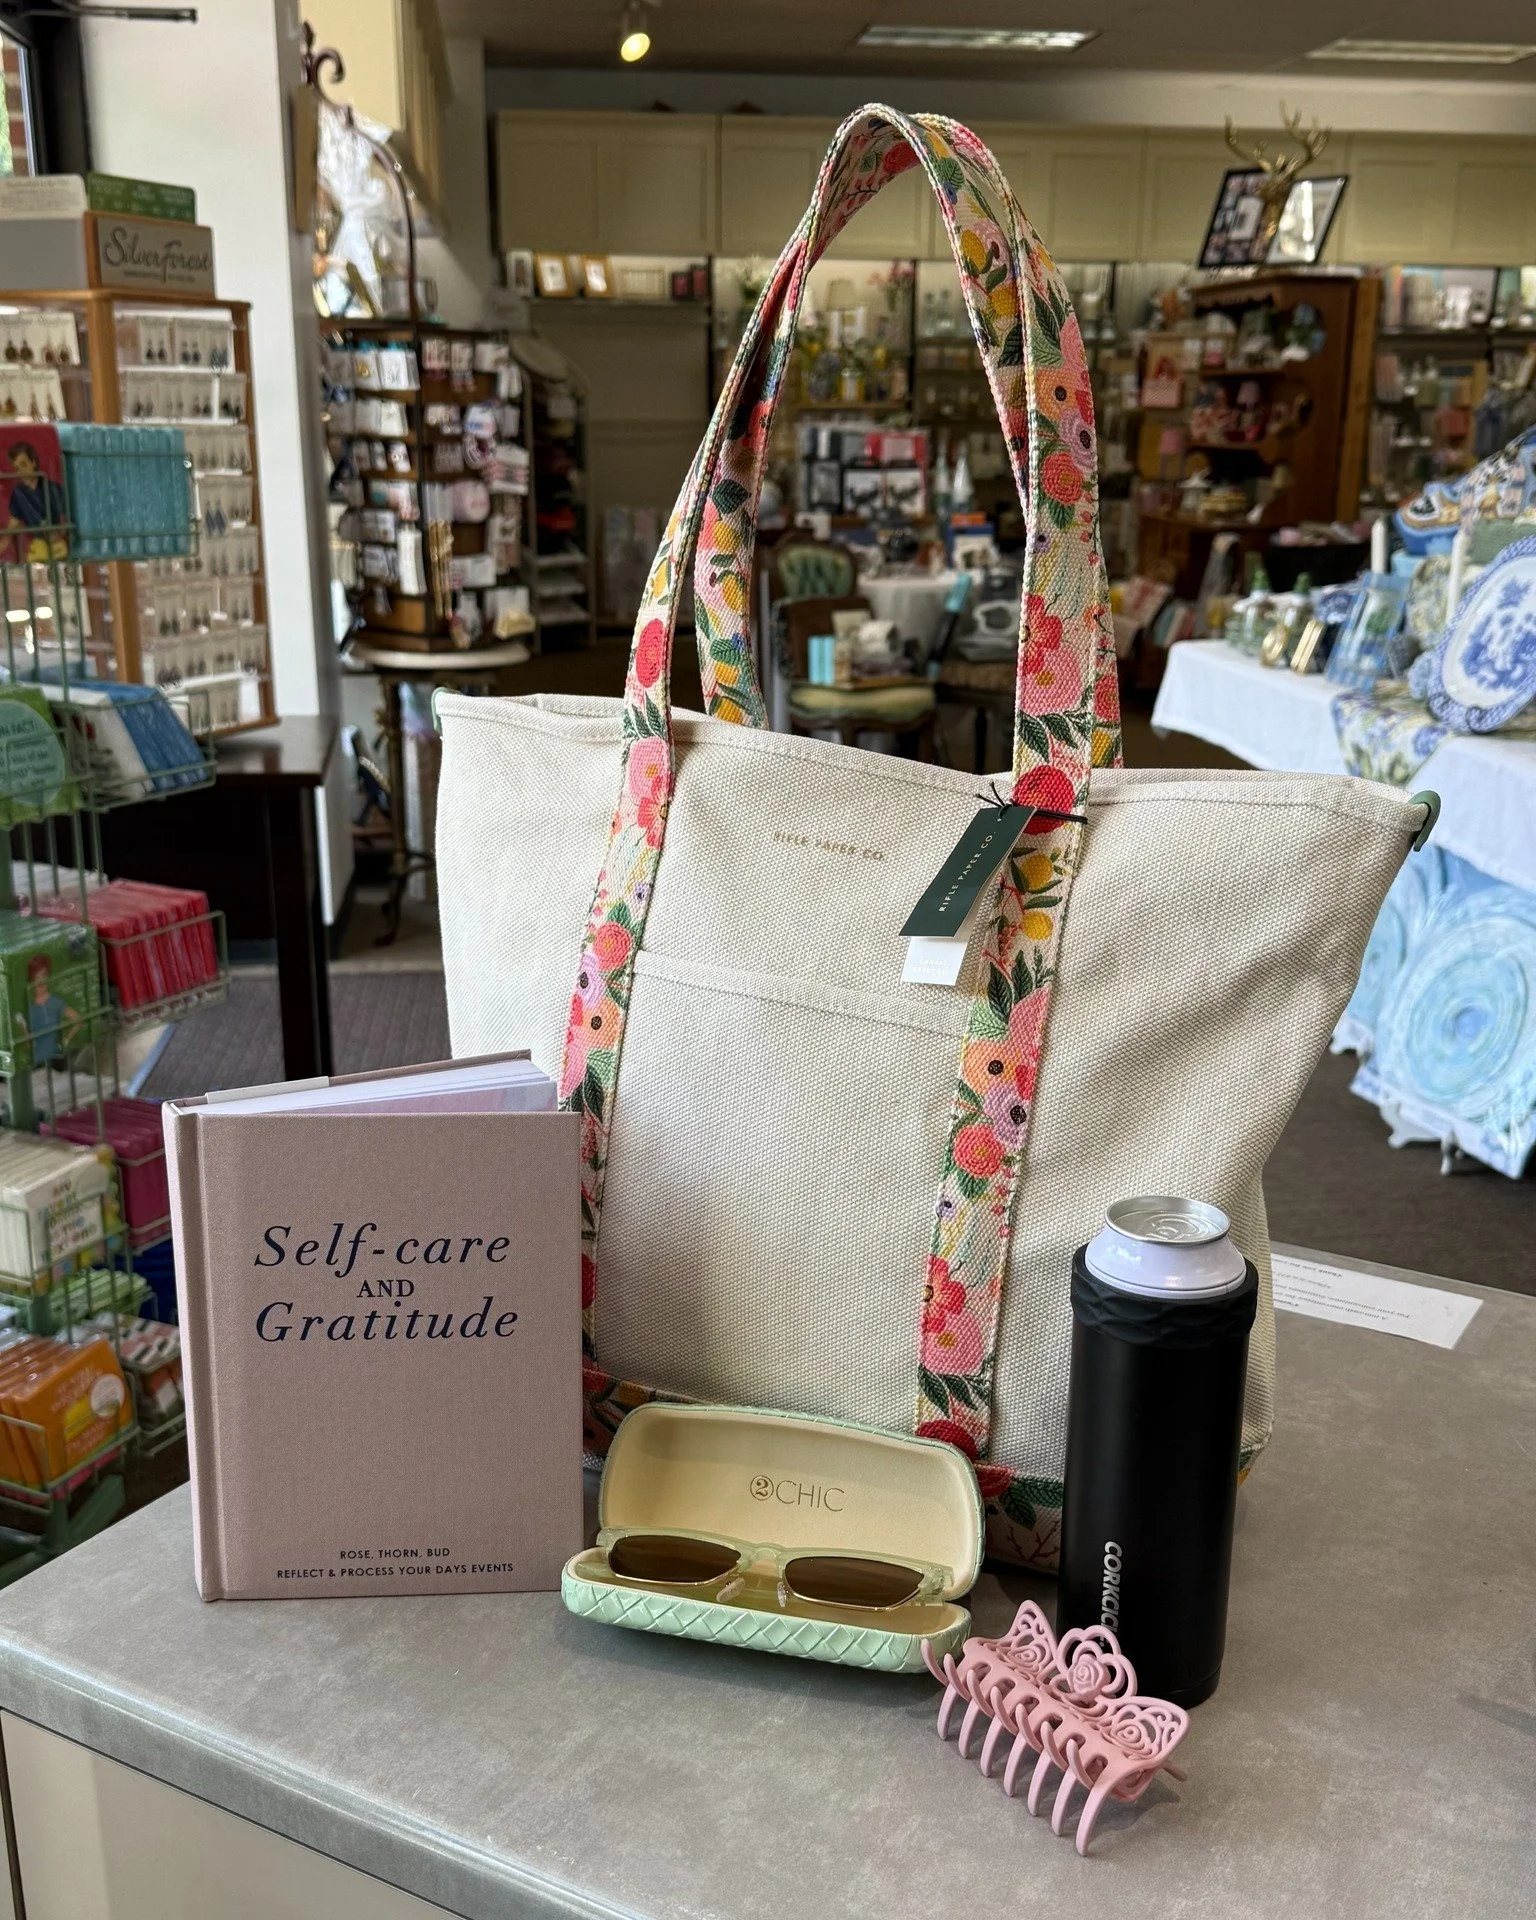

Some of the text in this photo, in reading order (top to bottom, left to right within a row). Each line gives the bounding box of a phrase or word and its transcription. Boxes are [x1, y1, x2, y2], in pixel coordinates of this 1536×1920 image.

[938, 831, 996, 912] RIFLE PAPER CO.
[253, 1222, 511, 1279] Self-care
[356, 1279, 415, 1298] AND
[255, 1296, 519, 1342] Gratitude
[427, 1548, 450, 1557] BUD
[277, 1563, 514, 1579] REFLECT & PROCESS YOUR DAYS EVENTS
